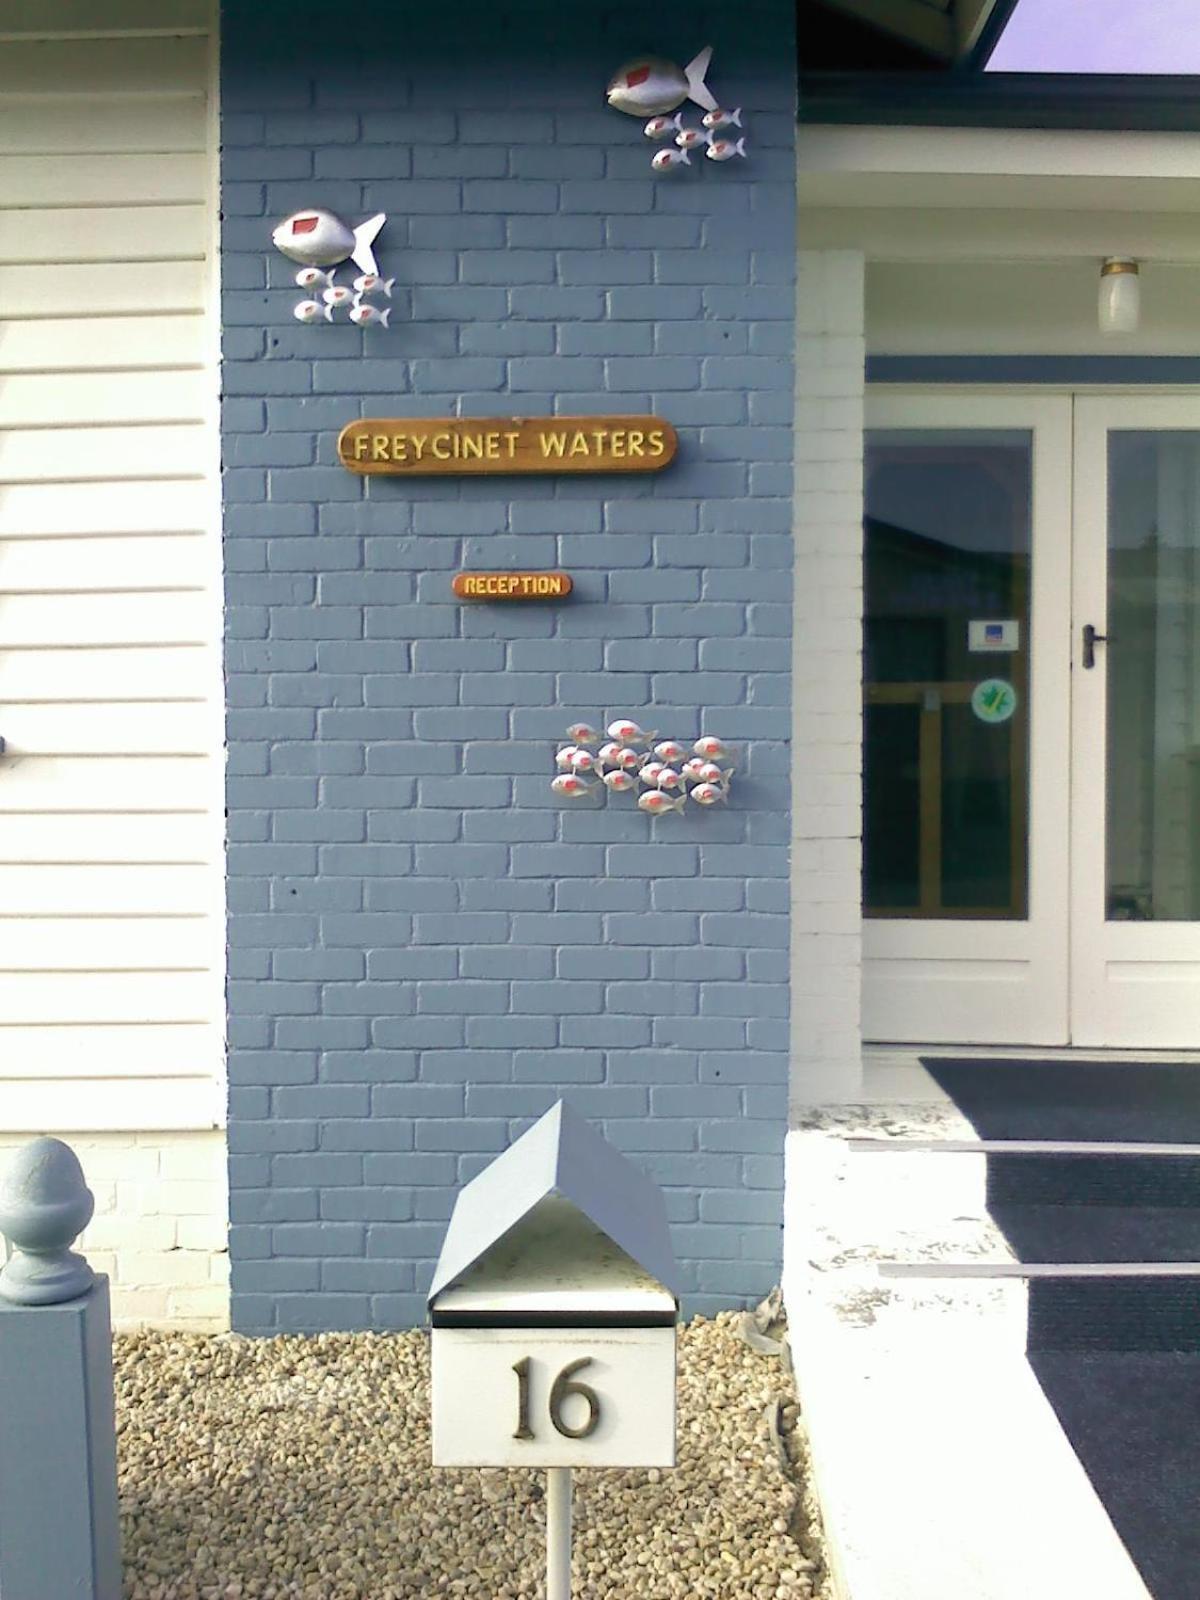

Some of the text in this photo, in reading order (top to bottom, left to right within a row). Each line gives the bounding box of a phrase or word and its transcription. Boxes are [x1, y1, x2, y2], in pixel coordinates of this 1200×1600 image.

[354, 430, 665, 460] FREYCINET WATERS
[464, 575, 561, 595] RECEPTION
[511, 1355, 600, 1440] 16
